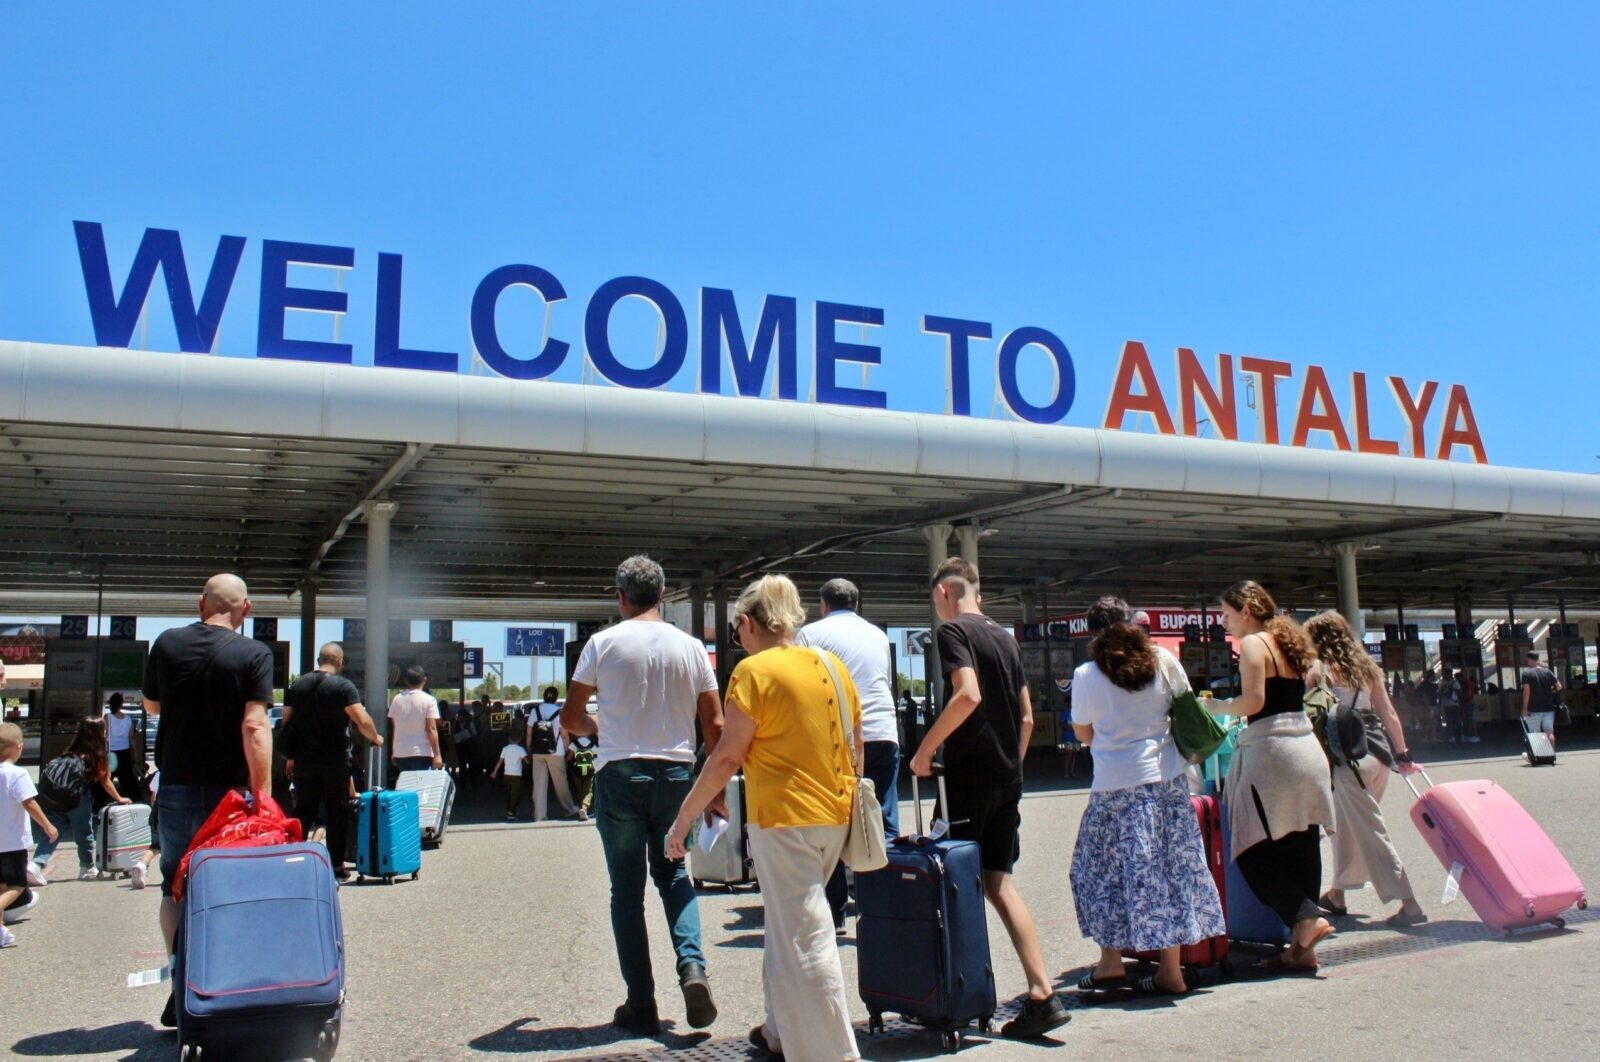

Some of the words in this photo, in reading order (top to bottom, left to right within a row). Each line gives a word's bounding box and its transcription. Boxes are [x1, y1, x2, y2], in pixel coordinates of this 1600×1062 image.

[73, 220, 887, 409] WELCOME
[923, 314, 1076, 424] TO
[1104, 340, 1488, 464] ANTALYA
[62, 620, 87, 635] 25
[111, 620, 135, 636] 26
[255, 621, 275, 636] 28
[1069, 618, 1089, 633] KIN
